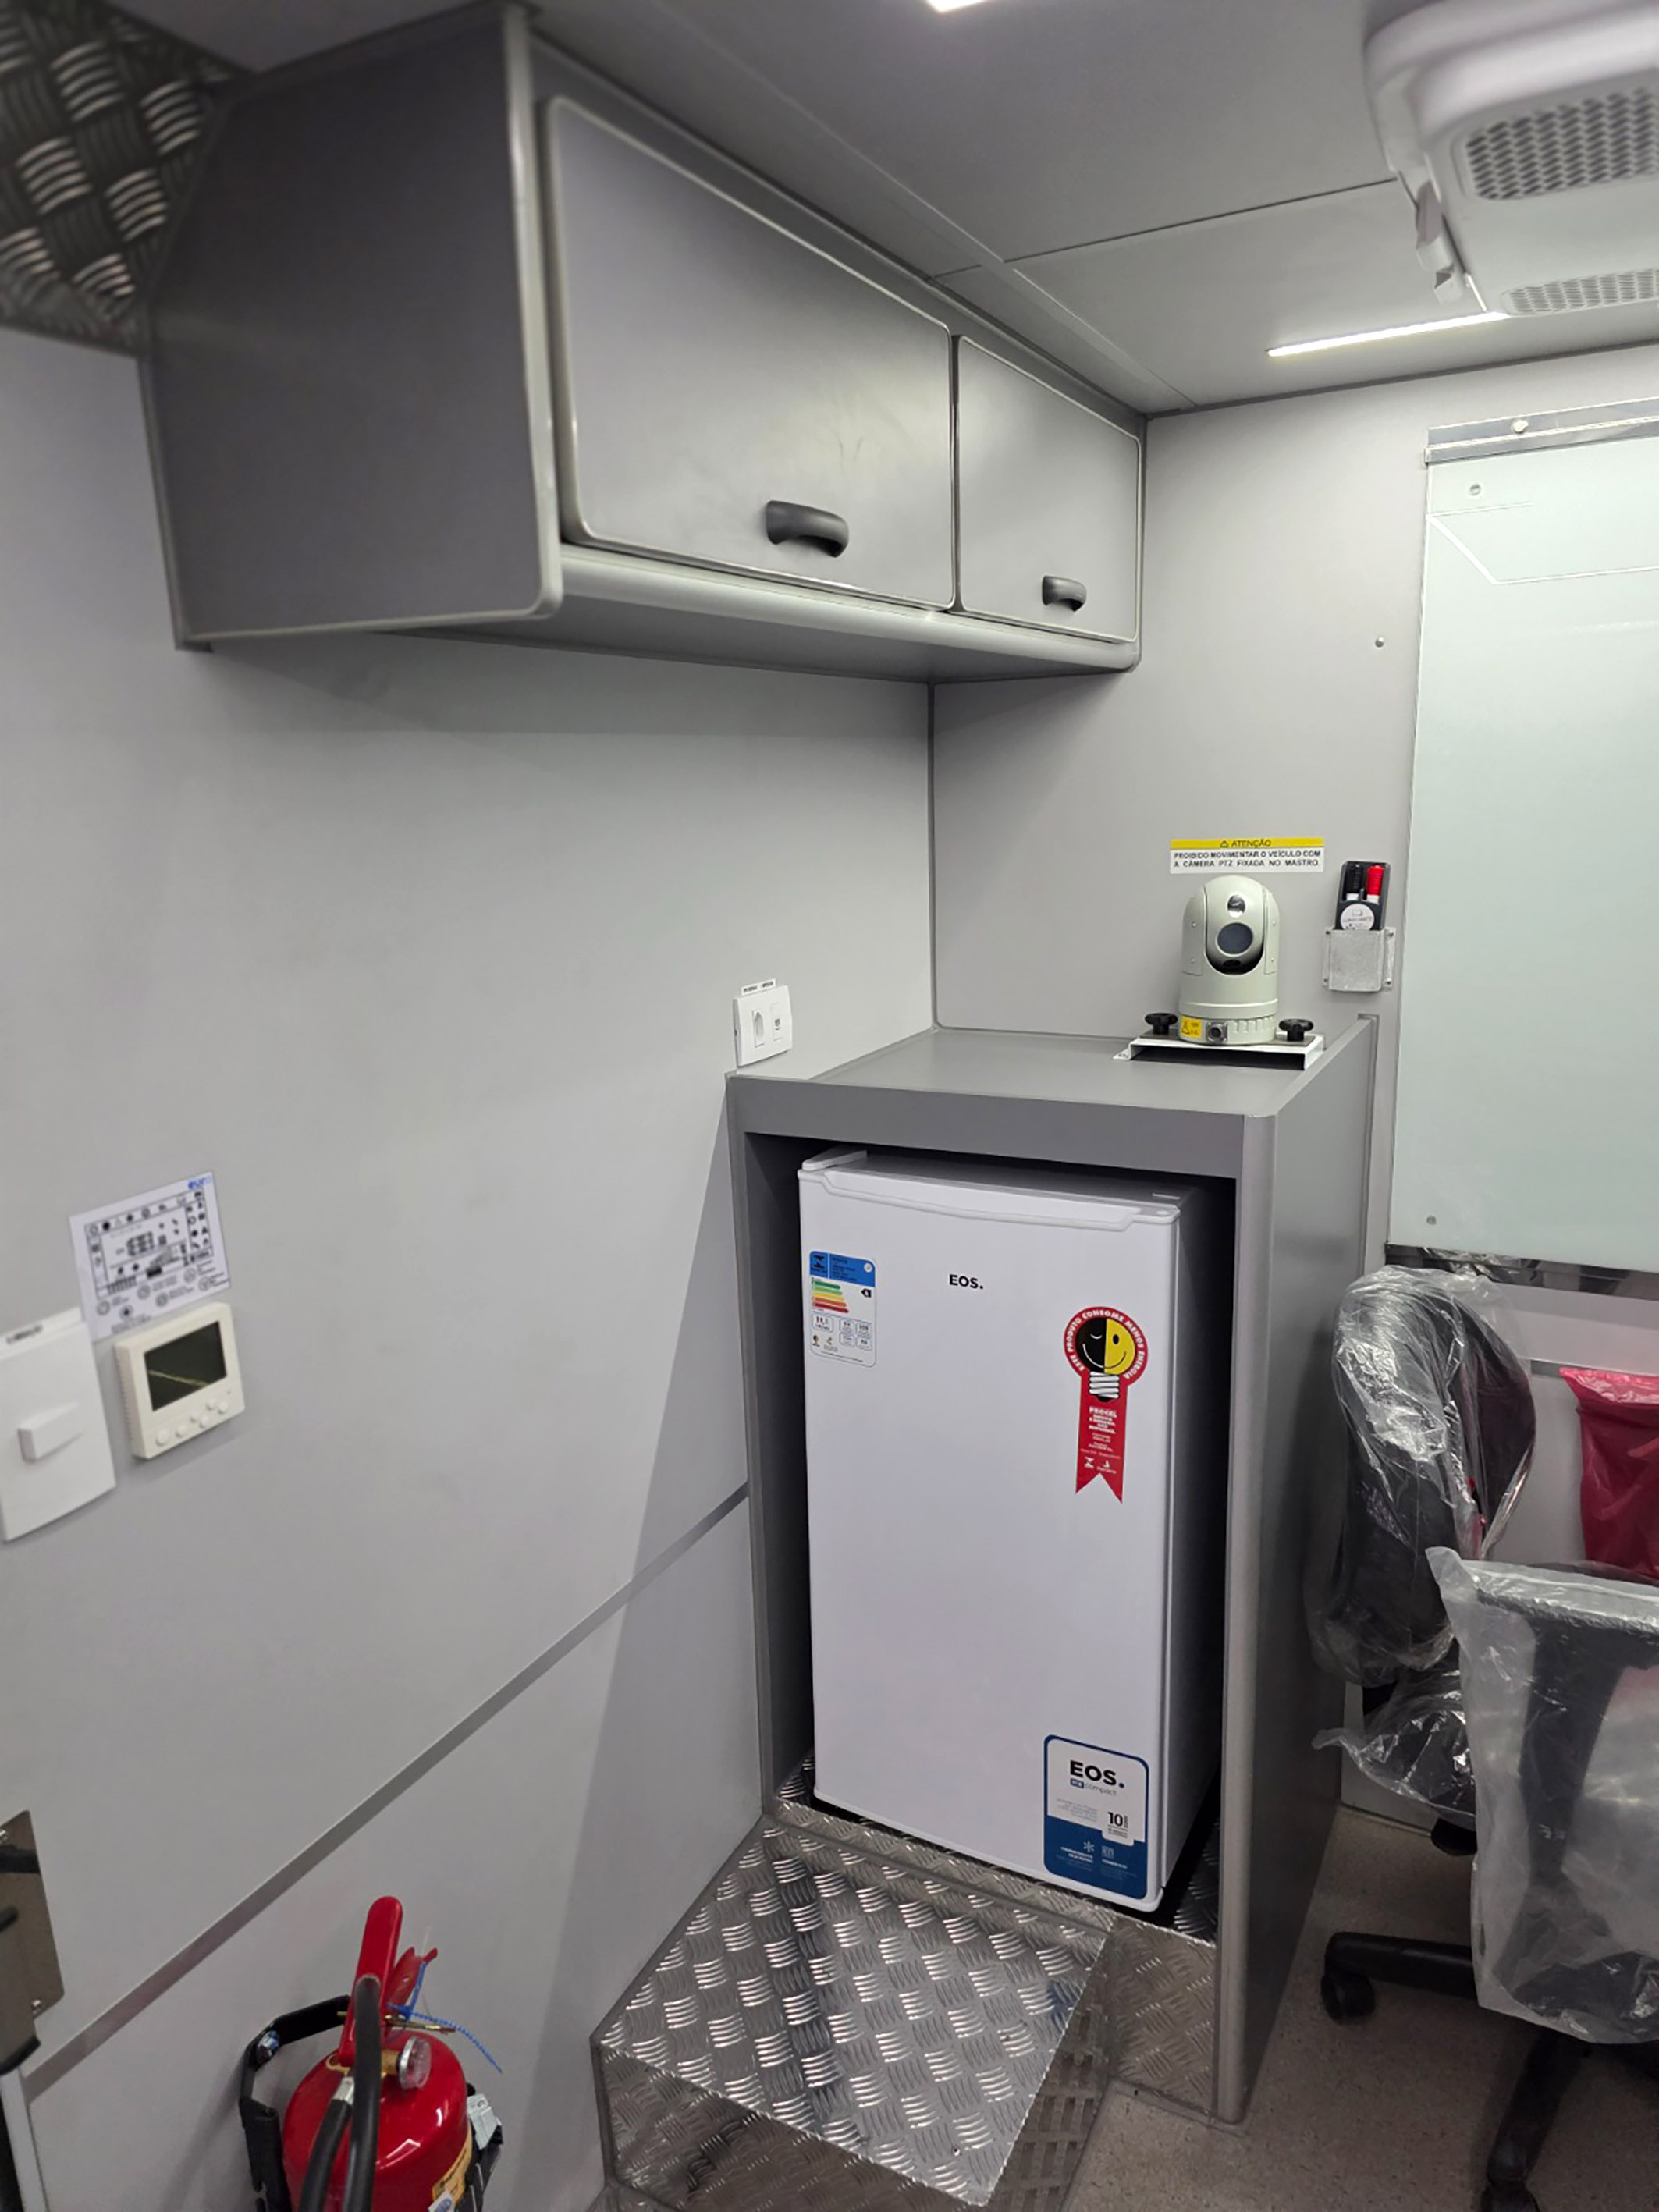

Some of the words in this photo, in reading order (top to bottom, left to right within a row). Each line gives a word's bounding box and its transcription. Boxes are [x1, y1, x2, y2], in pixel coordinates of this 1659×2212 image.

[1231, 839, 1271, 848] ATENÇÃO
[1183, 859, 1215, 868] CÂMERA
[949, 1273, 984, 1290] EOS.
[1066, 1317, 1082, 1353] PRODUTO
[1082, 1309, 1124, 1323] CONSOME
[1124, 1320, 1144, 1349] MENOS
[1069, 1759, 1125, 1789] EOS.
[1107, 1811, 1123, 1827] 10
